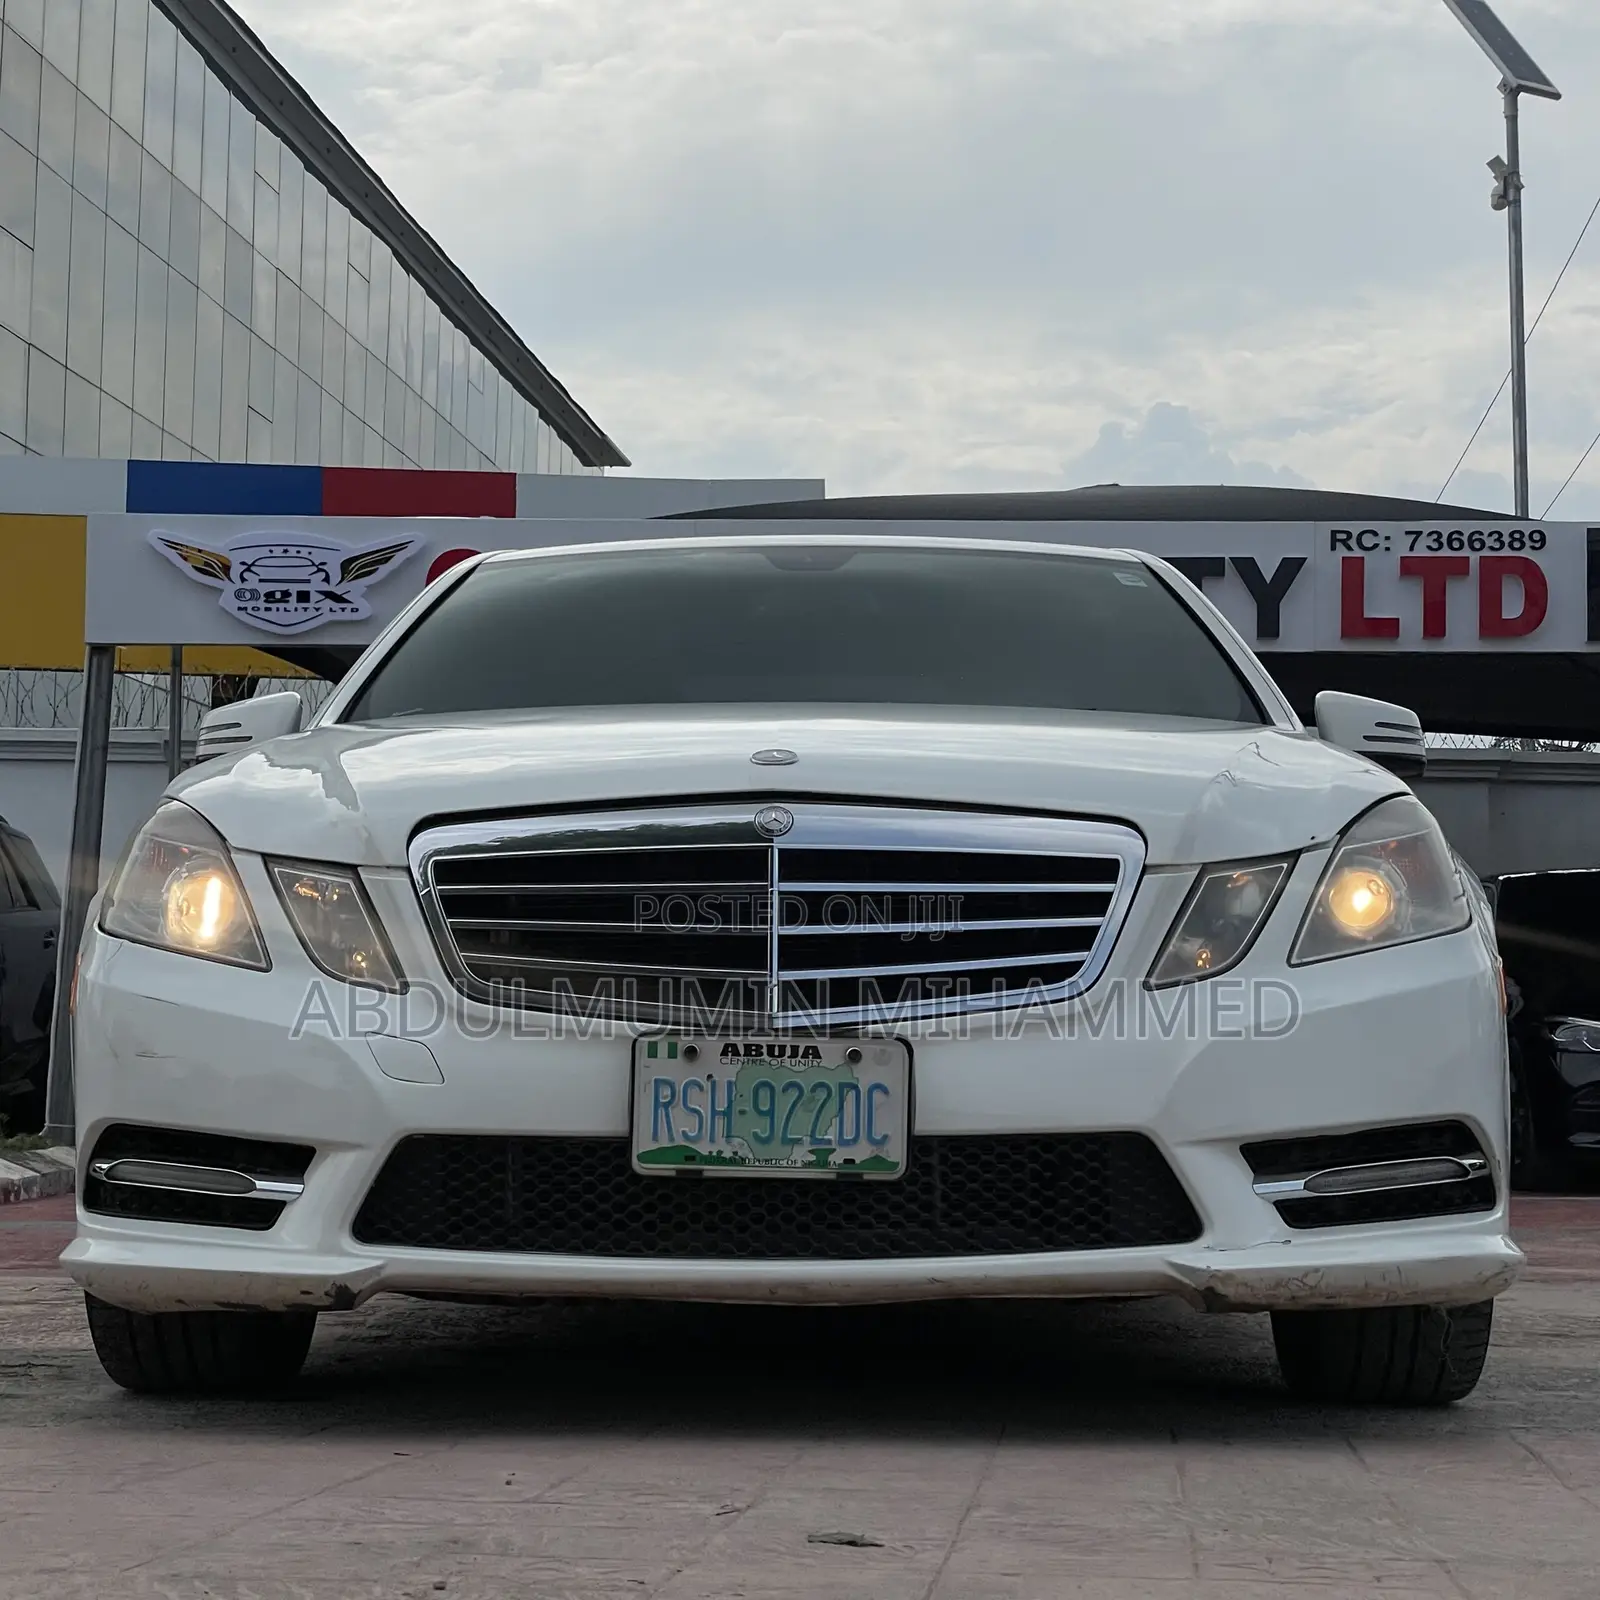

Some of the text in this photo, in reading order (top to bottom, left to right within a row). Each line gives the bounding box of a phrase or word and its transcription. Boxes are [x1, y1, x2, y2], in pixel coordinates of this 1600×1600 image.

[1330, 529, 1547, 552] RC: 7366389
[1341, 556, 1549, 639] LTD
[720, 1043, 822, 1059] ABUJA
[720, 1058, 822, 1068] CENTRE OF UNITY
[741, 1157, 784, 1166] REPUBLIC
[786, 1158, 798, 1166] OF
[801, 1159, 838, 1168] NIGIA
